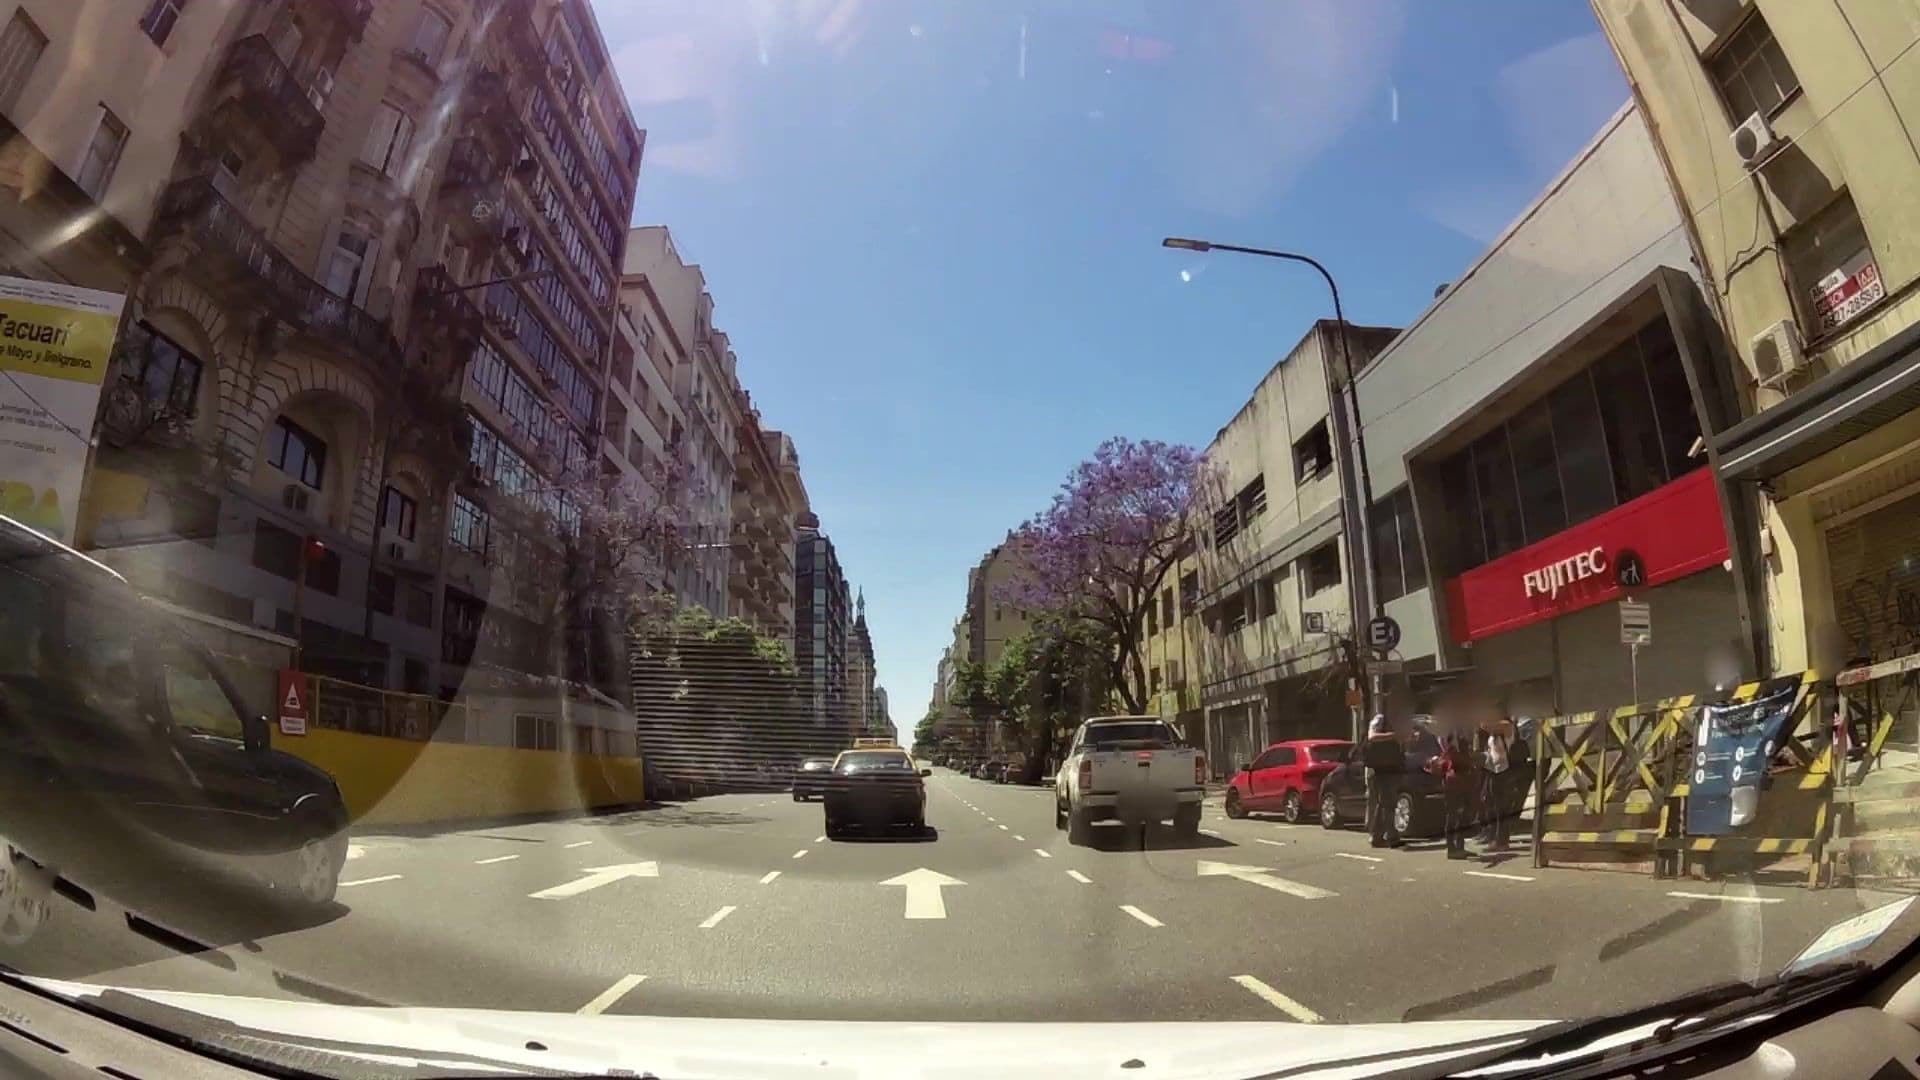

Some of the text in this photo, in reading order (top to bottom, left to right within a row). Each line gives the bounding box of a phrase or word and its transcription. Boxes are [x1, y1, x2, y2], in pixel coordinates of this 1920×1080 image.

[7, 345, 33, 361] Mayo
[1523, 546, 1607, 600] FUJITEC
[1370, 622, 1386, 645] E
